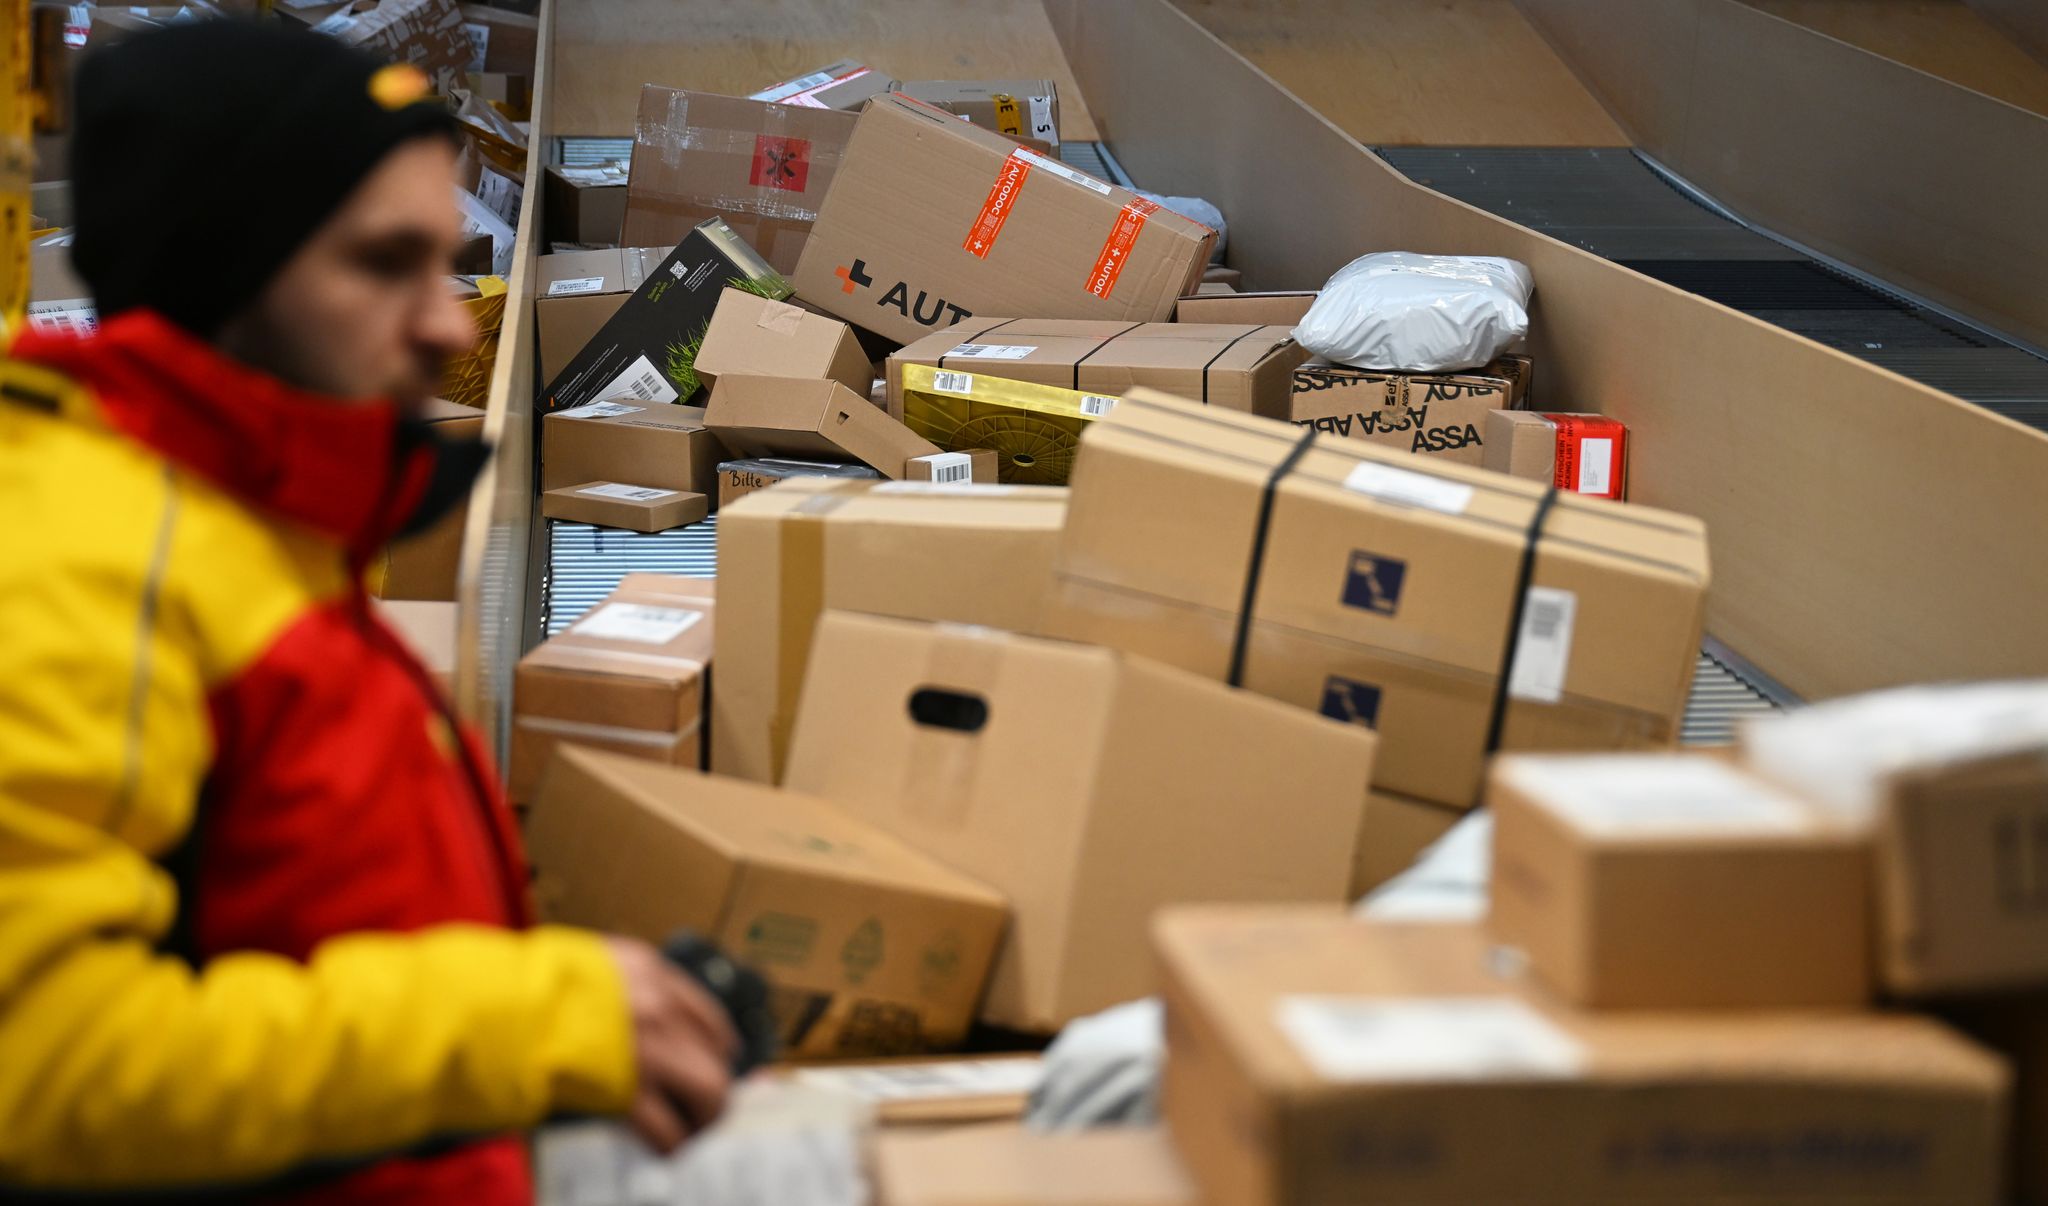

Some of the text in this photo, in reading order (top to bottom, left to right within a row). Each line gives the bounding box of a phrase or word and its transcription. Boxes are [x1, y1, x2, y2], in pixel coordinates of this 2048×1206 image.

[991, 164, 1020, 216] AUTODOC
[1093, 258, 1115, 296] AUTOD
[877, 281, 972, 326] AUT
[1291, 415, 1352, 437] ABL
[1411, 424, 1482, 453] ASSA
[729, 471, 763, 488] Bitte
